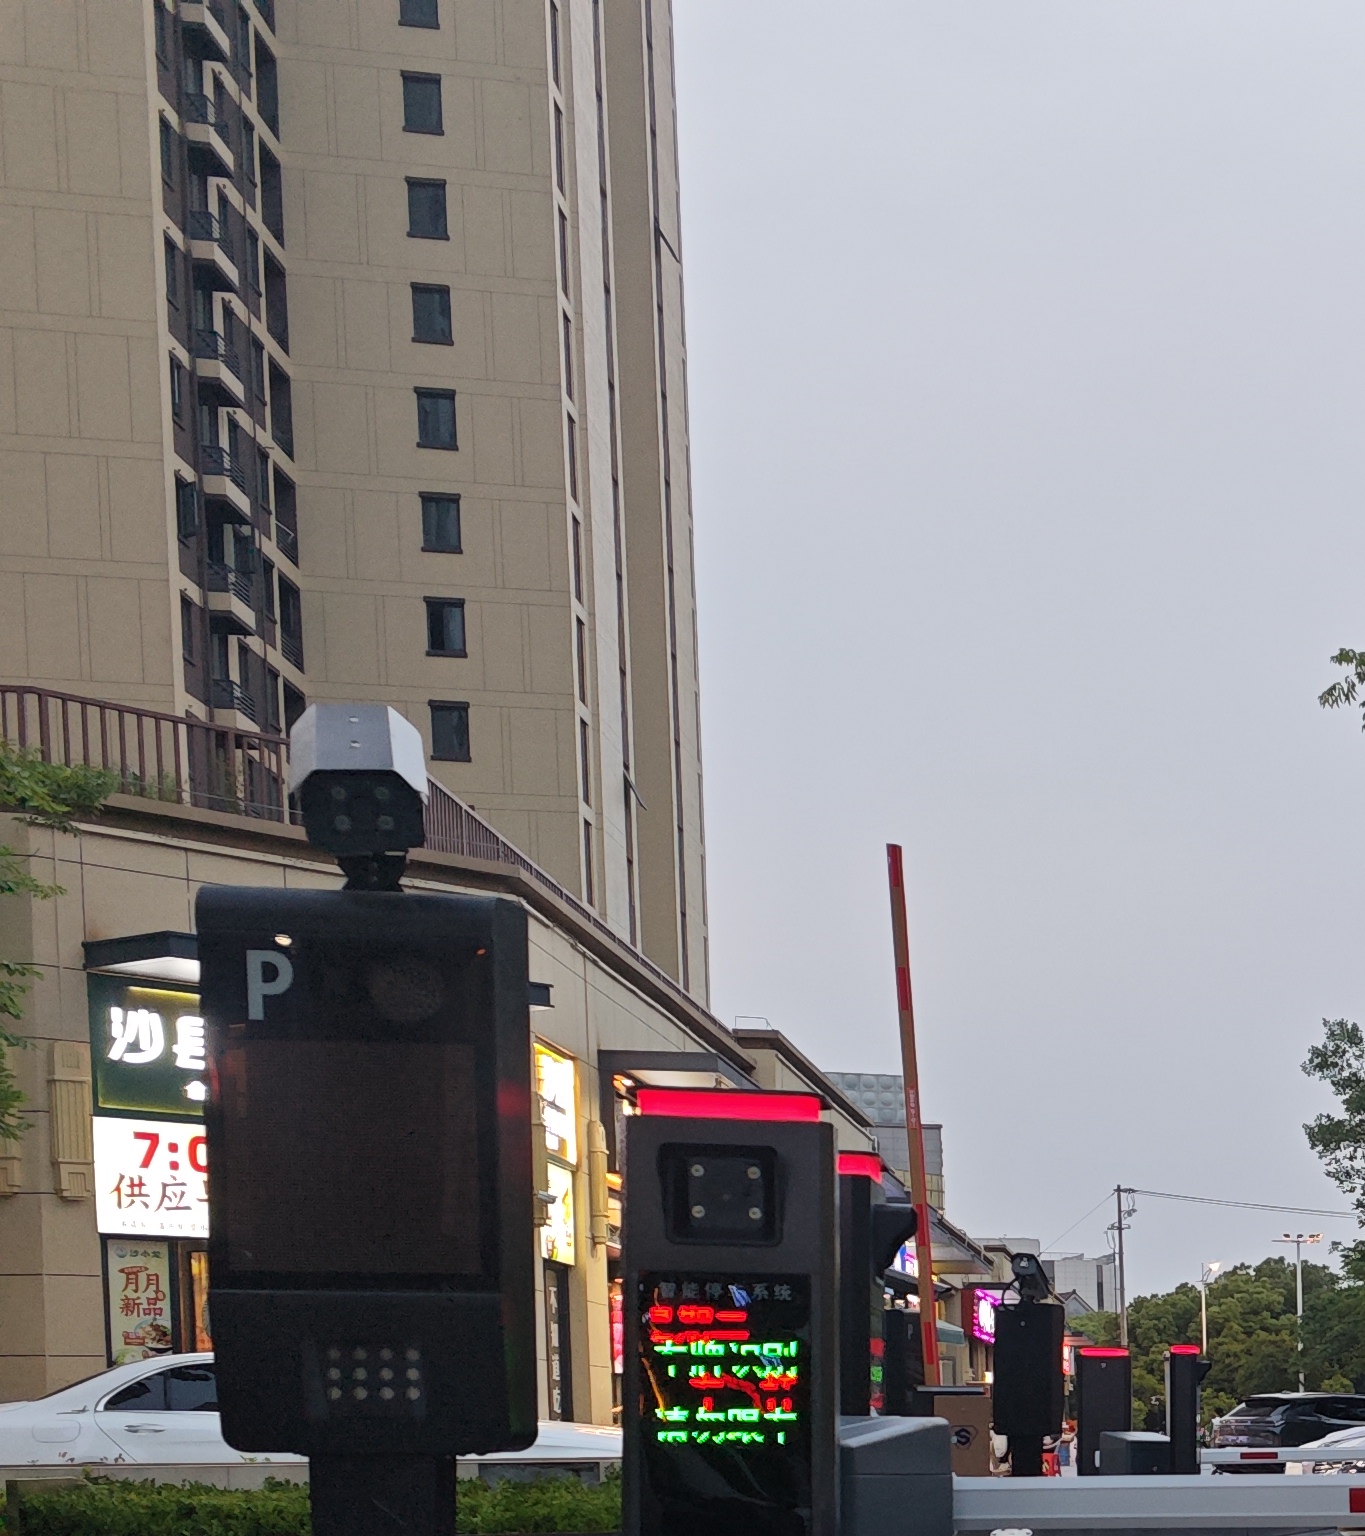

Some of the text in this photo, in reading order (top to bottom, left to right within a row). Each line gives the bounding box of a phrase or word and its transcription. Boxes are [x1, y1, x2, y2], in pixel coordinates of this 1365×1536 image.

[246, 949, 294, 1021] P
[659, 1281, 793, 1301] 智能停系统
[119, 1294, 164, 1318] 新品
